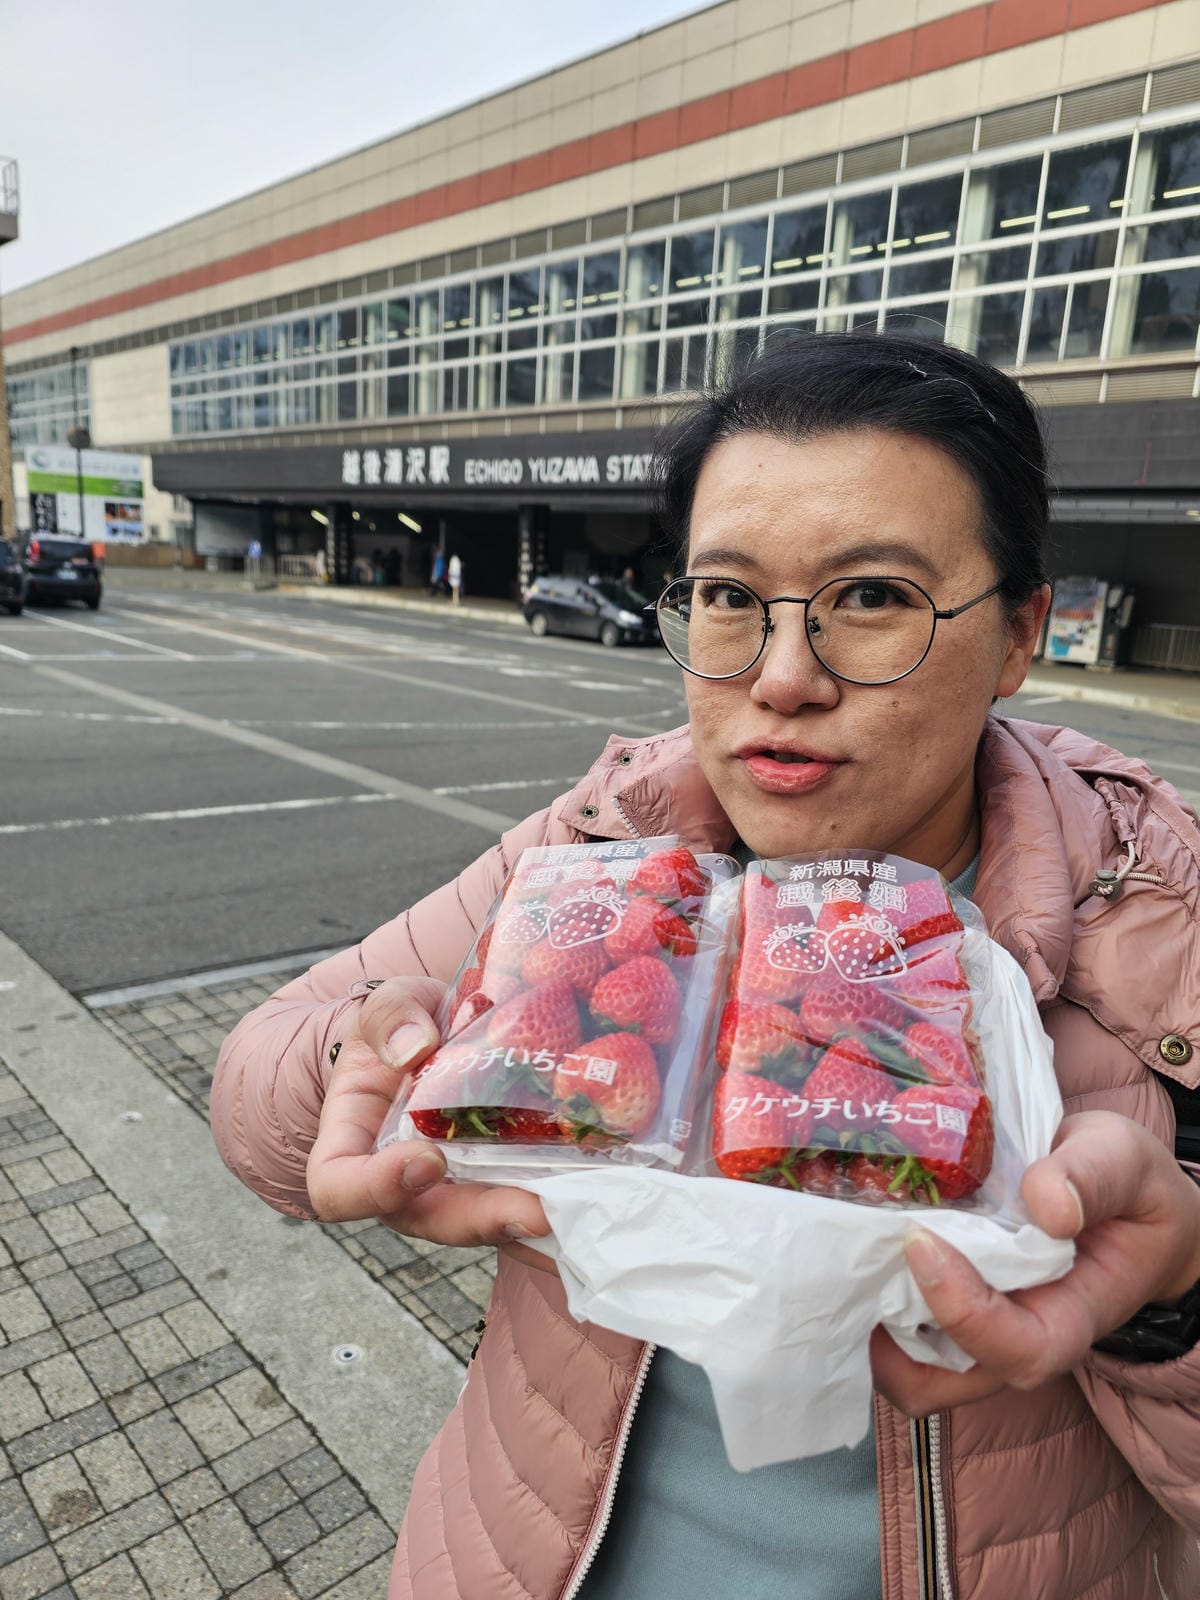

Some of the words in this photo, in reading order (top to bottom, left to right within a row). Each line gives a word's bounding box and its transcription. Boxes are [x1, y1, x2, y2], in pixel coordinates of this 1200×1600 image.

[464, 458, 523, 484] ECHIGO
[528, 456, 600, 484] YUZAWA
[606, 454, 668, 482] STAT
[788, 859, 897, 883] 新潟県産
[776, 878, 907, 913] 越後姫
[724, 1092, 967, 1136] タケウチいちご園
